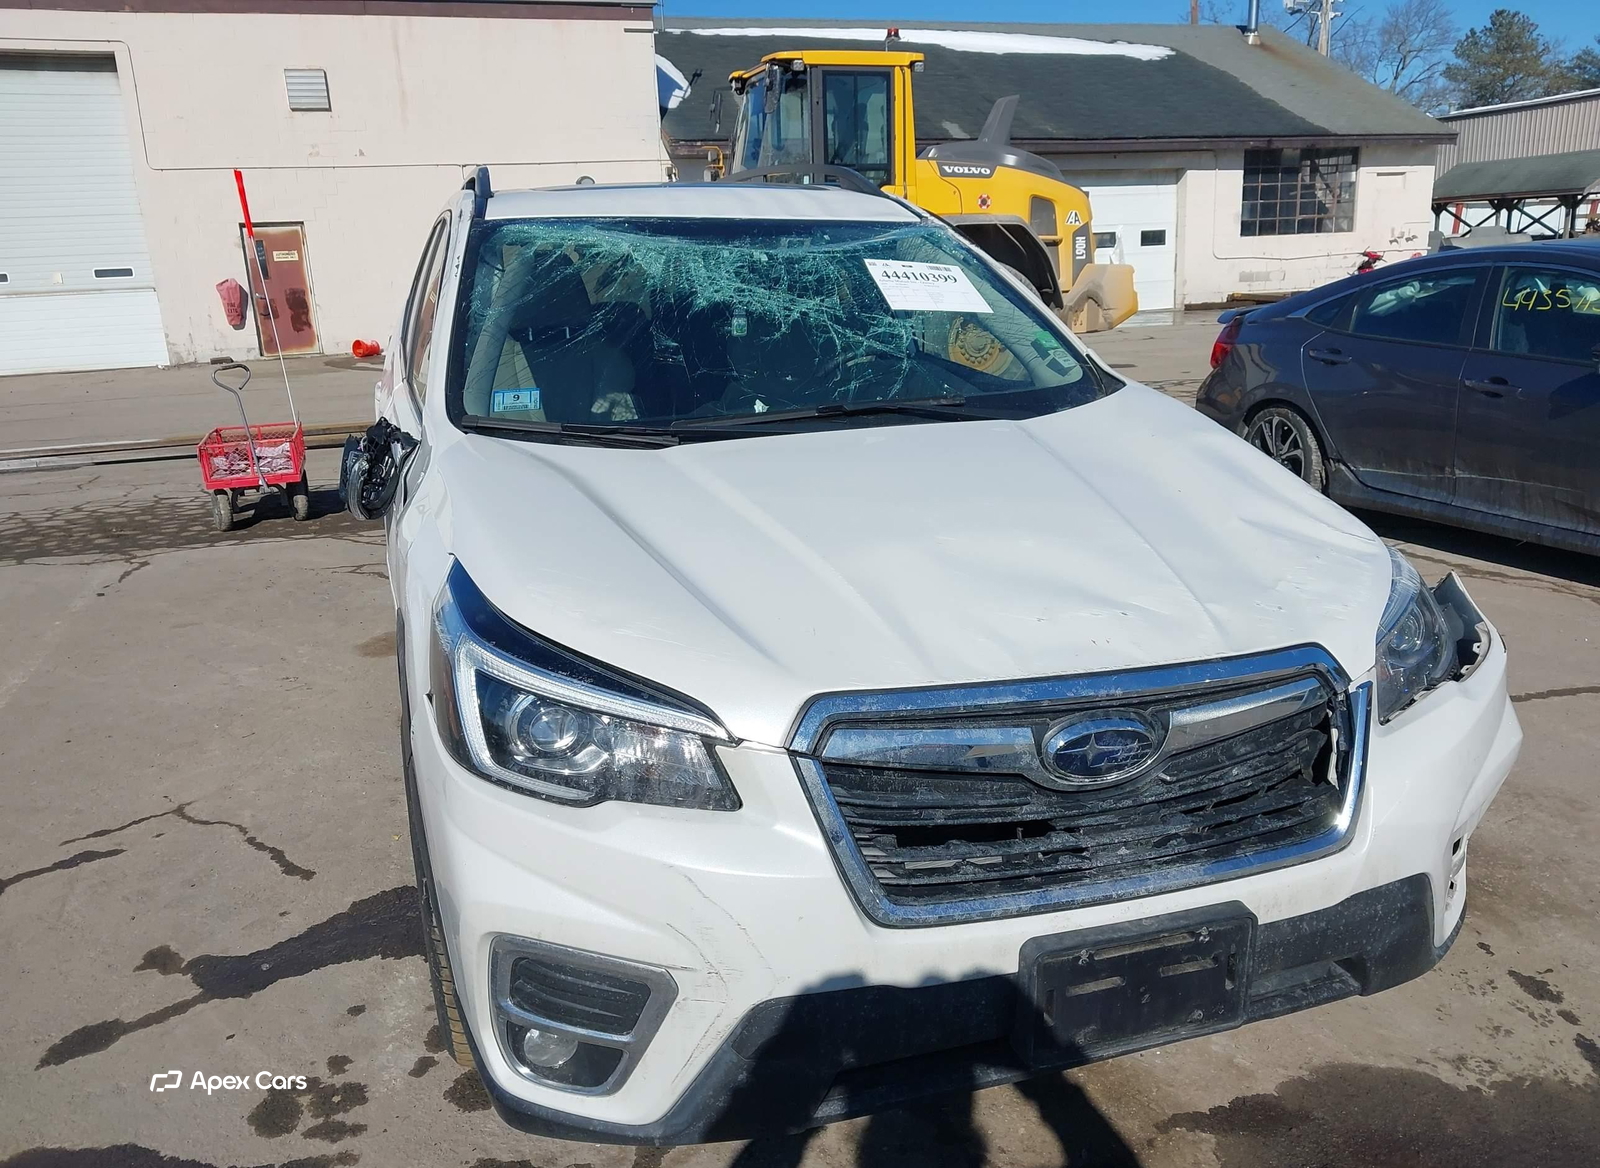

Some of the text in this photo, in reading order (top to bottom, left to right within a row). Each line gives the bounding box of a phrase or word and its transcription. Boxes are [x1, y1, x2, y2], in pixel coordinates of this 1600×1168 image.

[942, 165, 991, 175] VOLVO
[1075, 236, 1086, 260] L90H
[881, 270, 958, 284] 44410399
[512, 394, 520, 402] 9
